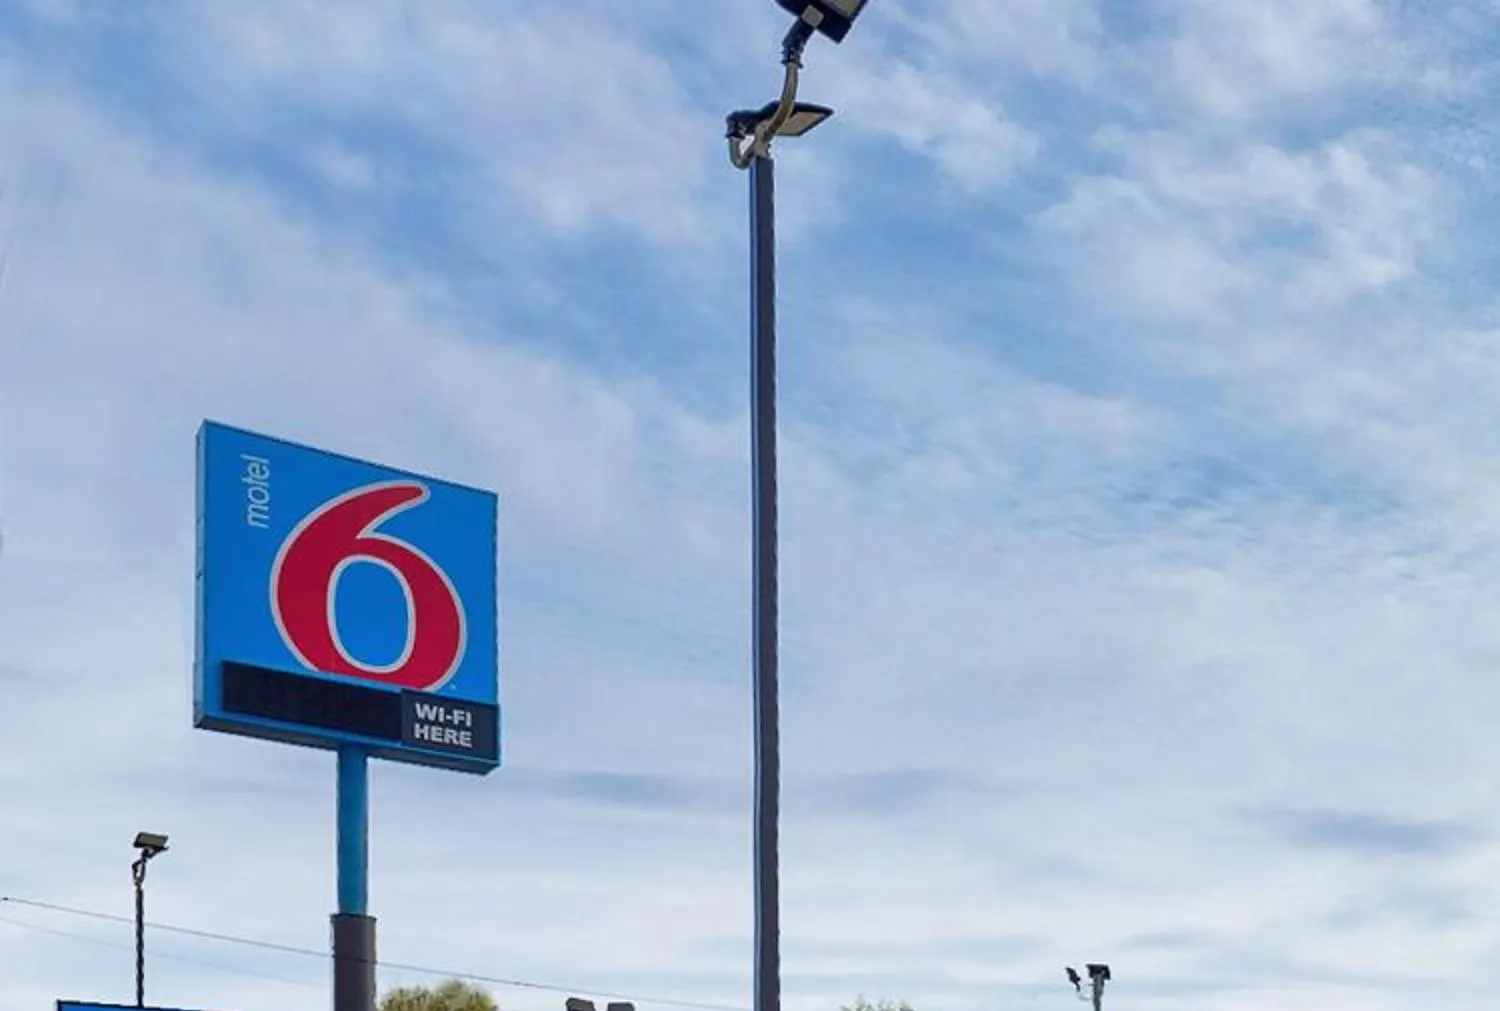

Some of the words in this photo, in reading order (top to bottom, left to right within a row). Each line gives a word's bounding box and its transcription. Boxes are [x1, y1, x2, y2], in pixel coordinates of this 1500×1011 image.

[239, 453, 269, 529] motel
[271, 481, 465, 691] 6
[414, 723, 472, 748] HERE
[415, 703, 472, 727] WI-FI
